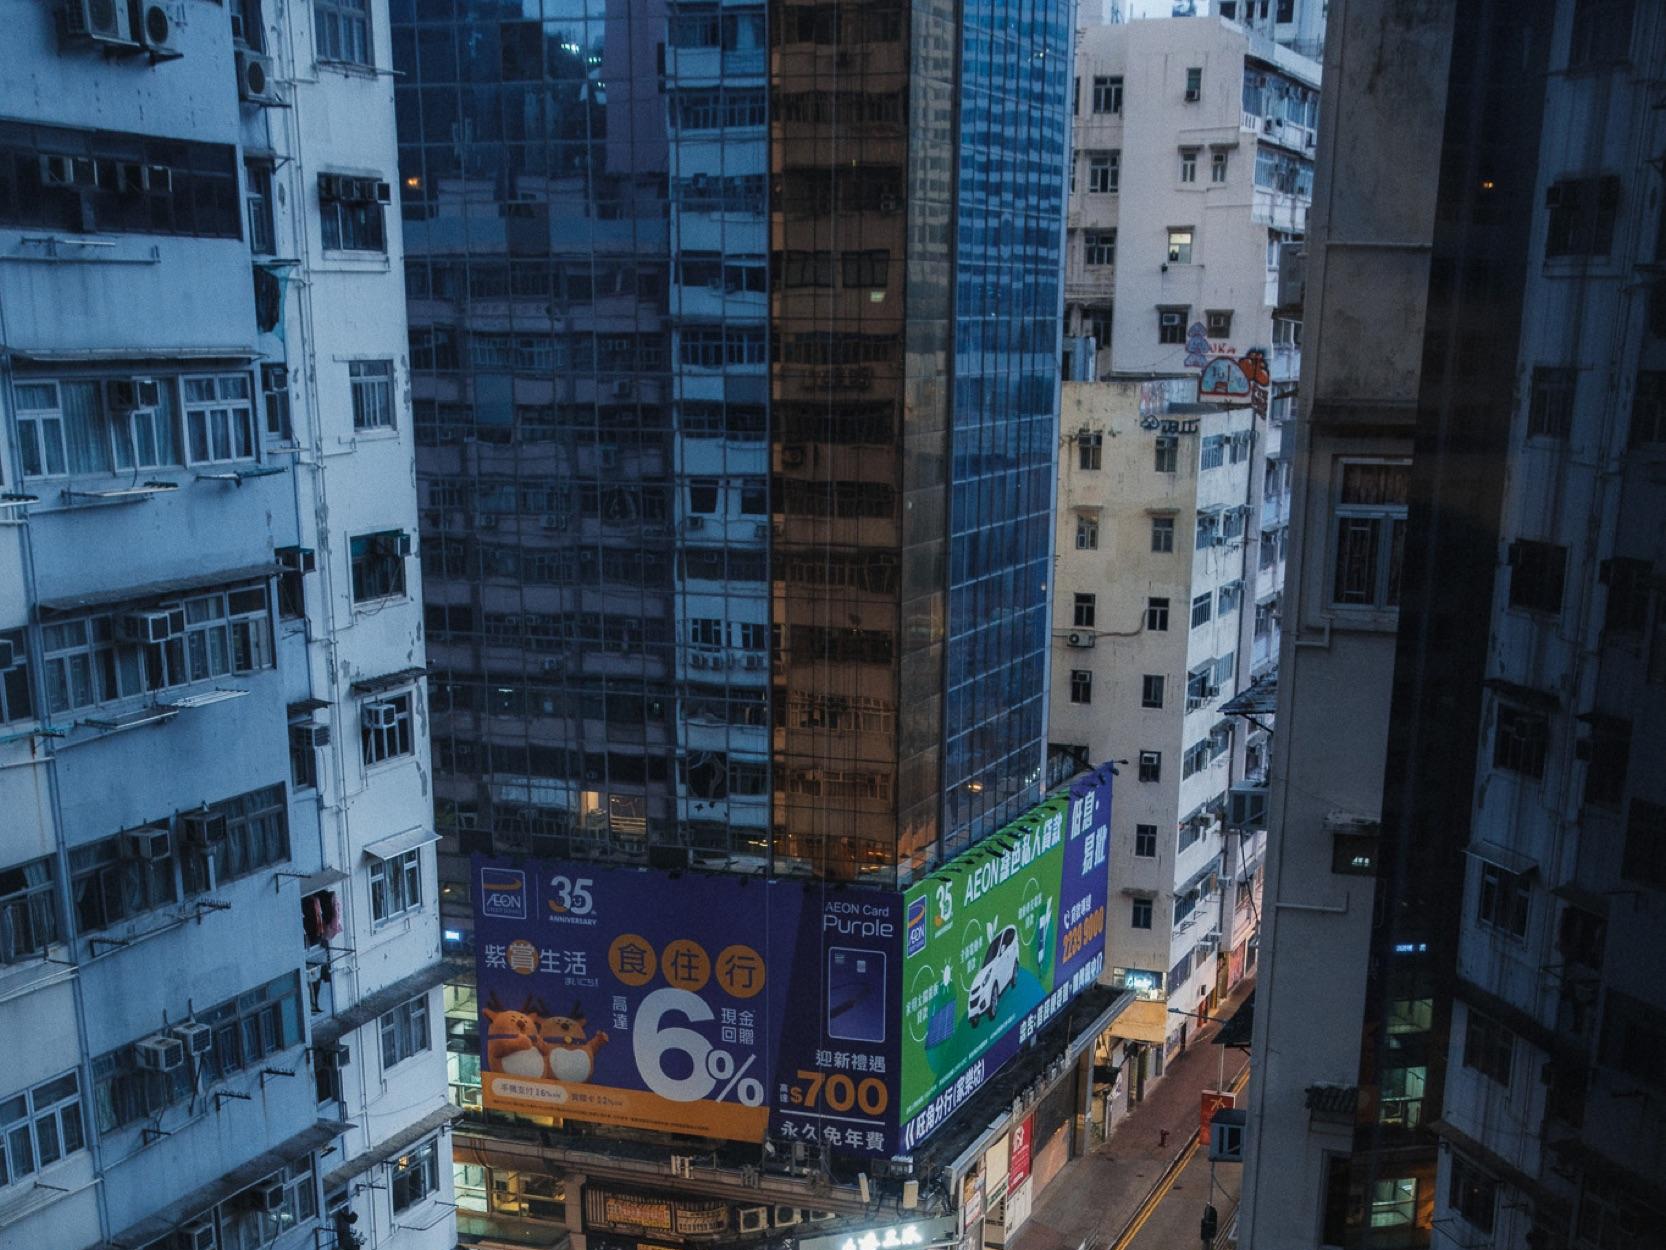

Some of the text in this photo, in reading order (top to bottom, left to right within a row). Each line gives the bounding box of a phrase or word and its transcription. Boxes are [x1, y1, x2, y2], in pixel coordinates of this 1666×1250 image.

[548, 875, 593, 915] 35
[825, 901, 889, 917] AEON Card
[823, 914, 894, 938] Purple
[484, 943, 588, 977] 紫賞生活
[617, 942, 757, 990] 食住行
[612, 995, 628, 1030] 高達
[721, 1007, 754, 1027] 現金
[632, 987, 765, 1108] 6%
[721, 1026, 754, 1045] 回贈
[816, 1049, 886, 1073] 迎新禮遇
[790, 1069, 888, 1116] $700
[781, 1120, 885, 1152] 永久免年費
